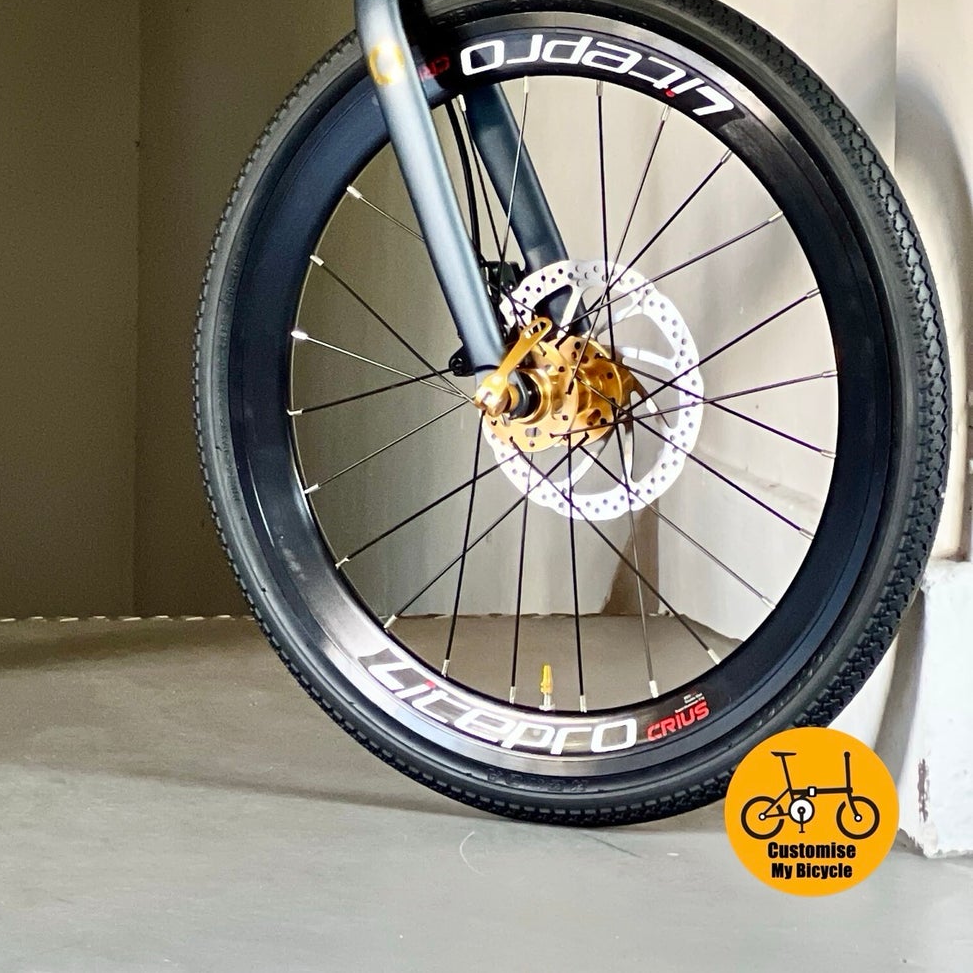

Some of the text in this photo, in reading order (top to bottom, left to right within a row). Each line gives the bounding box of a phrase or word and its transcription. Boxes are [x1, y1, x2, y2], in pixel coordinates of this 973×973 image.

[460, 34, 735, 117] Litepro
[367, 661, 638, 755] Litepro
[646, 700, 711, 742] CRIUS
